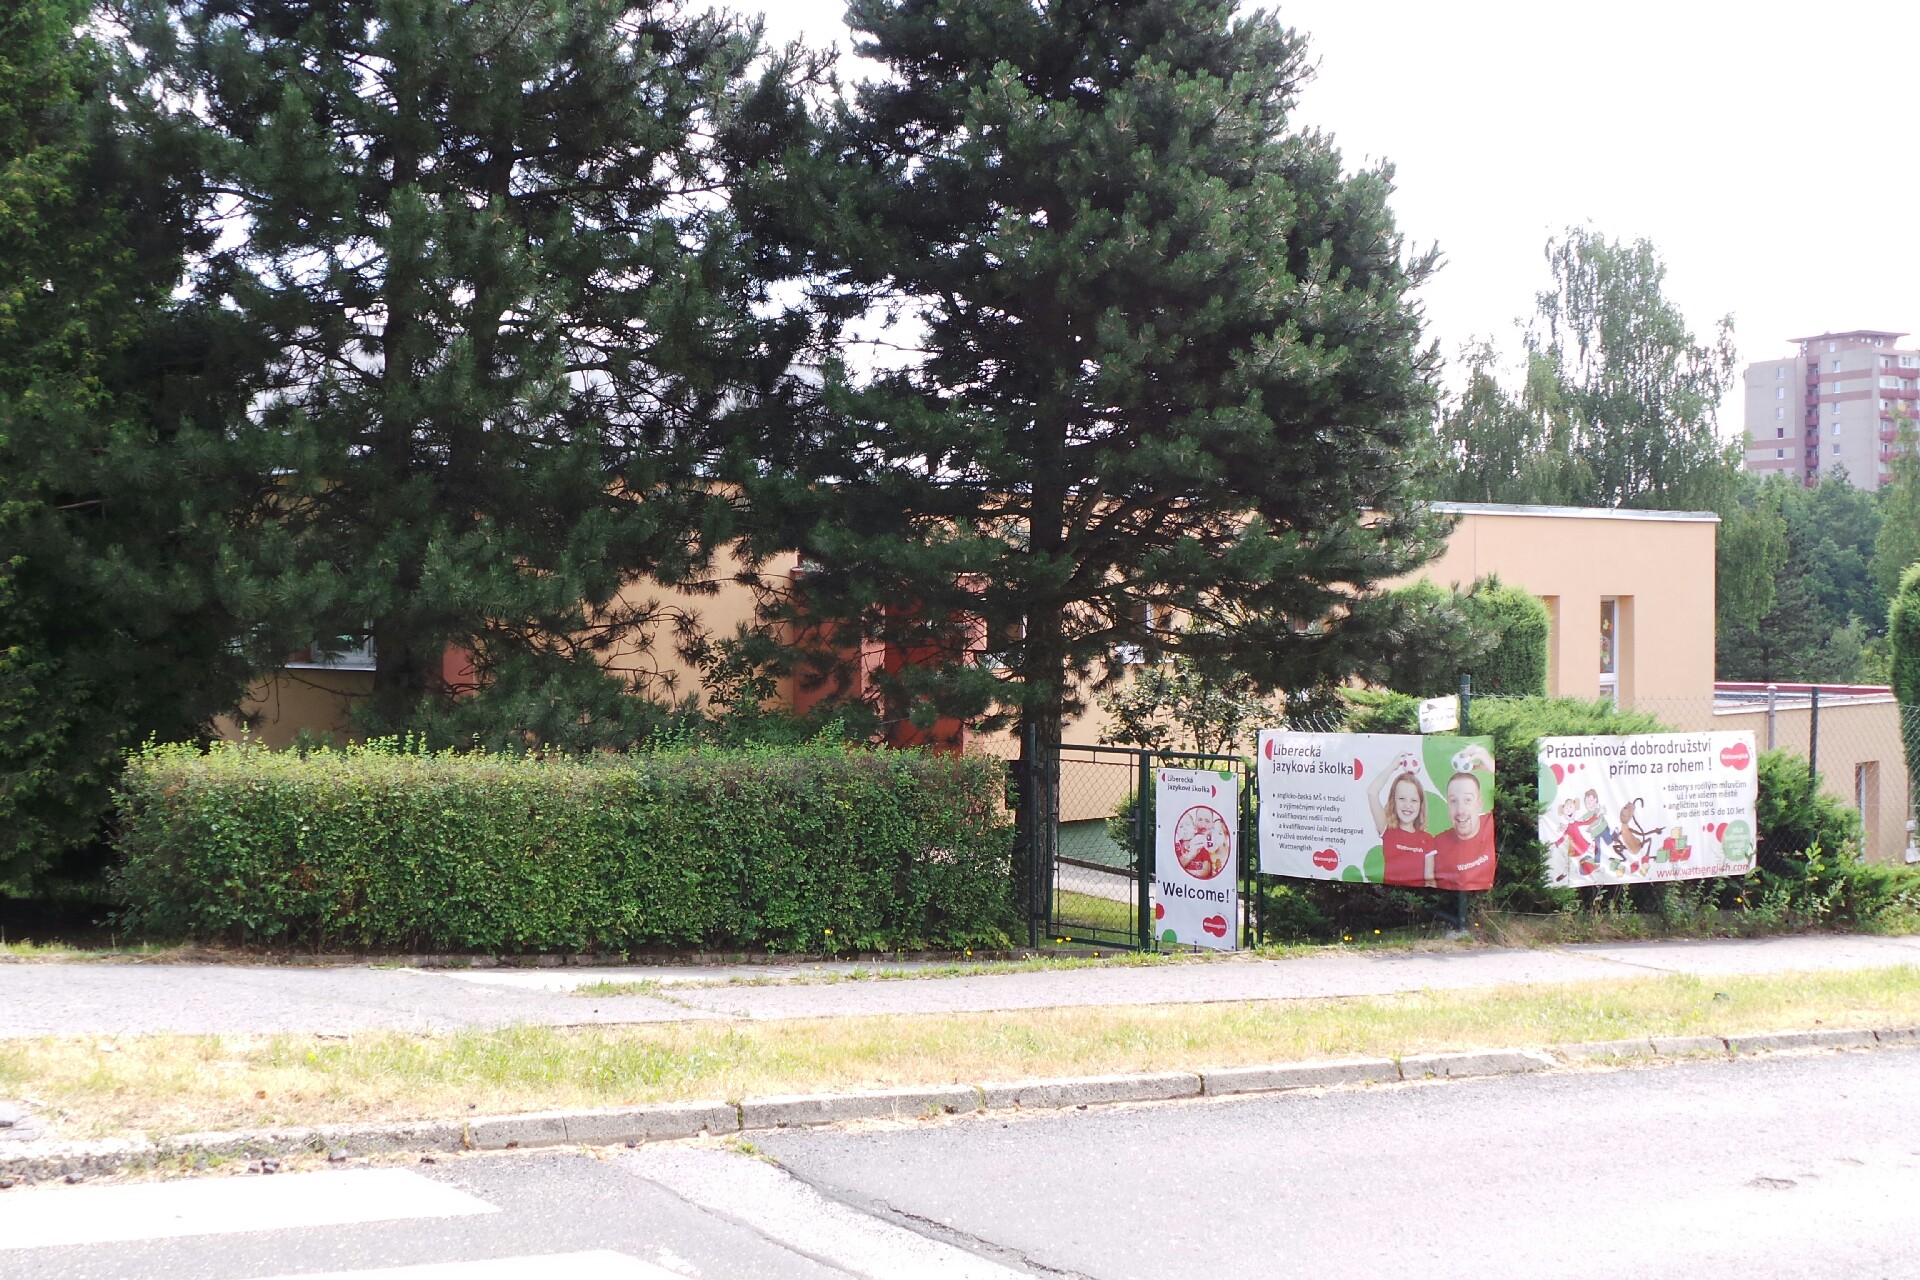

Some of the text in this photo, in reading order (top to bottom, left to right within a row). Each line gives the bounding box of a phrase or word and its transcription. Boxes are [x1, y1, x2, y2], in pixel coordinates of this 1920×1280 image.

[1274, 744, 1321, 758] Liberecká
[1546, 738, 1711, 758] Prázdninová dobrodružství
[1272, 760, 1354, 775] jazyková školka
[1610, 760, 1647, 779] přímo
[1650, 763, 1663, 773] za
[1667, 758, 1703, 772] rohem
[1168, 775, 1194, 784] Liberecká
[1192, 785, 1210, 793] školka
[1316, 804, 1340, 813] výsledky
[1656, 863, 1749, 877] www.wattsenglish.com
[1162, 882, 1230, 904] Welcome!
